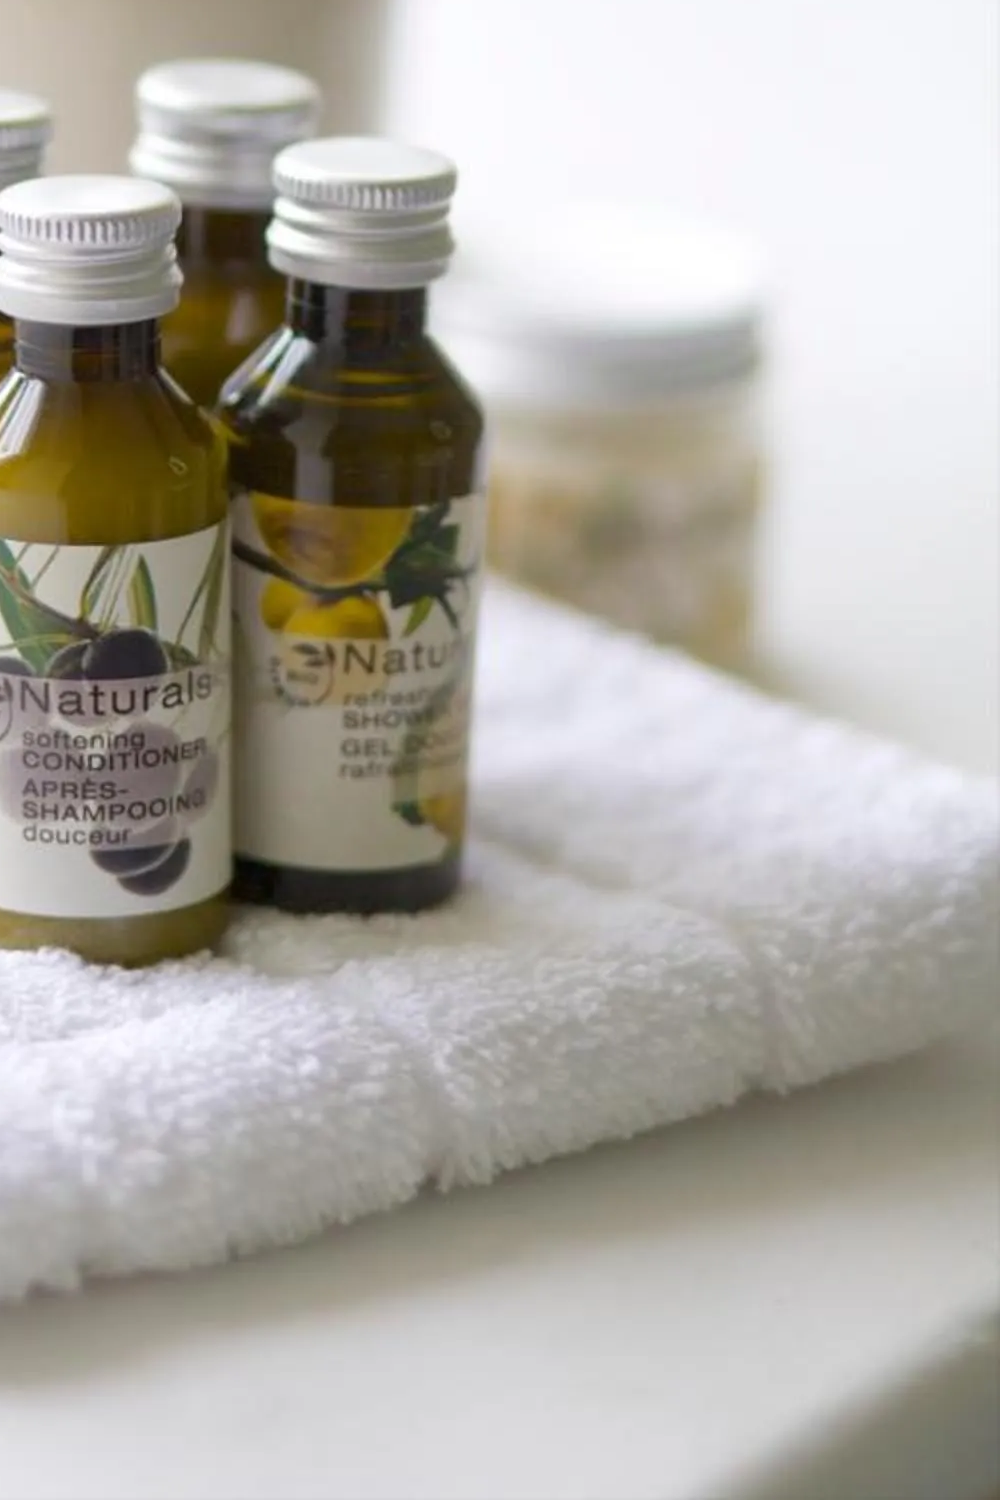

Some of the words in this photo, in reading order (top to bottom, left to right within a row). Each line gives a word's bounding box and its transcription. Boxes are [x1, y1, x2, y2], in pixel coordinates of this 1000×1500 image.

[18, 671, 213, 717] Naturals
[21, 730, 146, 751] softening
[340, 737, 394, 758] GEL
[22, 737, 208, 772] CONDITIONER
[22, 777, 131, 801] APRÈS-
[22, 787, 208, 822] SHAMPOOING
[22, 824, 132, 845] douceur
